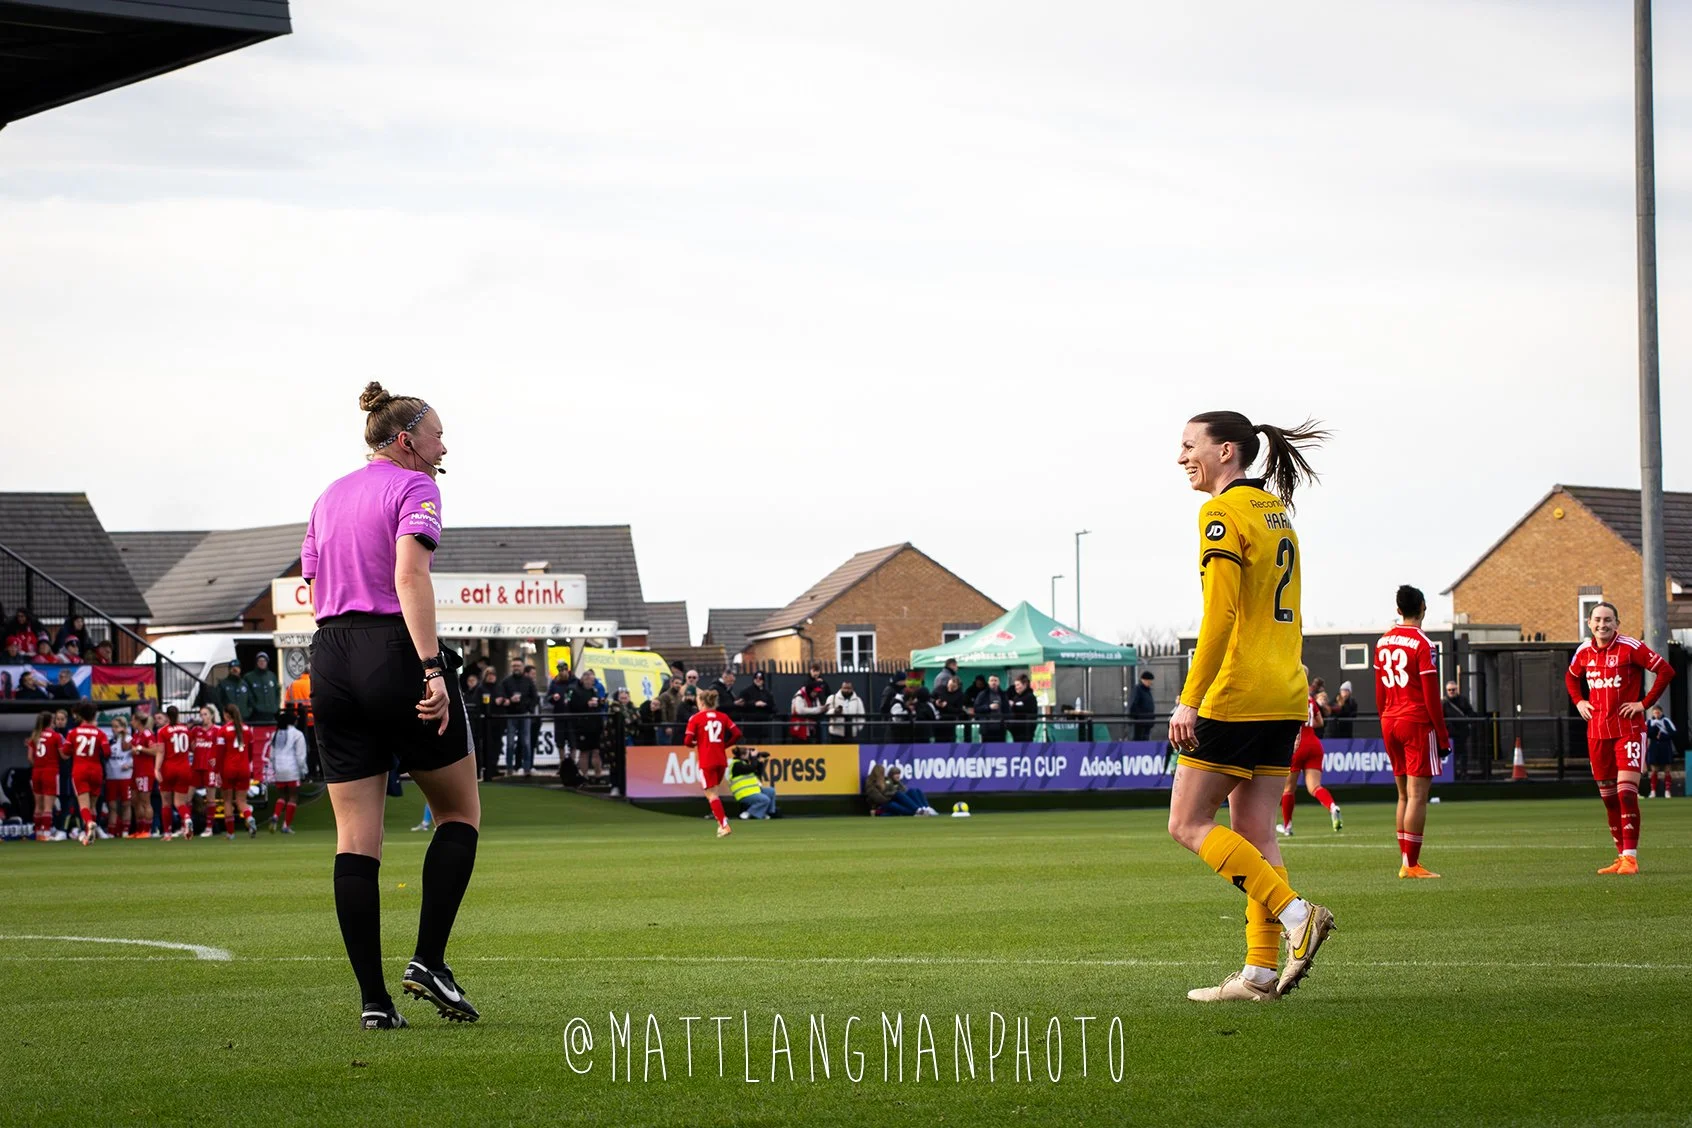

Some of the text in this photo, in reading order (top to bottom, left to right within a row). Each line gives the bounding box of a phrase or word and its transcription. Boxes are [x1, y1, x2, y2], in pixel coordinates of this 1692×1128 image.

[1206, 524, 1222, 537] JD
[1274, 537, 1295, 622] 2
[461, 581, 565, 604] eat & drink
[479, 625, 572, 634] FRESHLY COOKED CHIPS
[1379, 648, 1409, 688] 33
[171, 732, 189, 753] 10
[705, 720, 722, 743] 12
[36, 737, 47, 757] 5
[76, 735, 97, 757] 21
[1624, 741, 1640, 759] 13
[761, 757, 826, 784] xpress
[914, 757, 1008, 780] WOMEN'S
[1010, 756, 1031, 777] FA
[1034, 756, 1067, 777] CUP
[1079, 756, 1121, 777] Adobe
